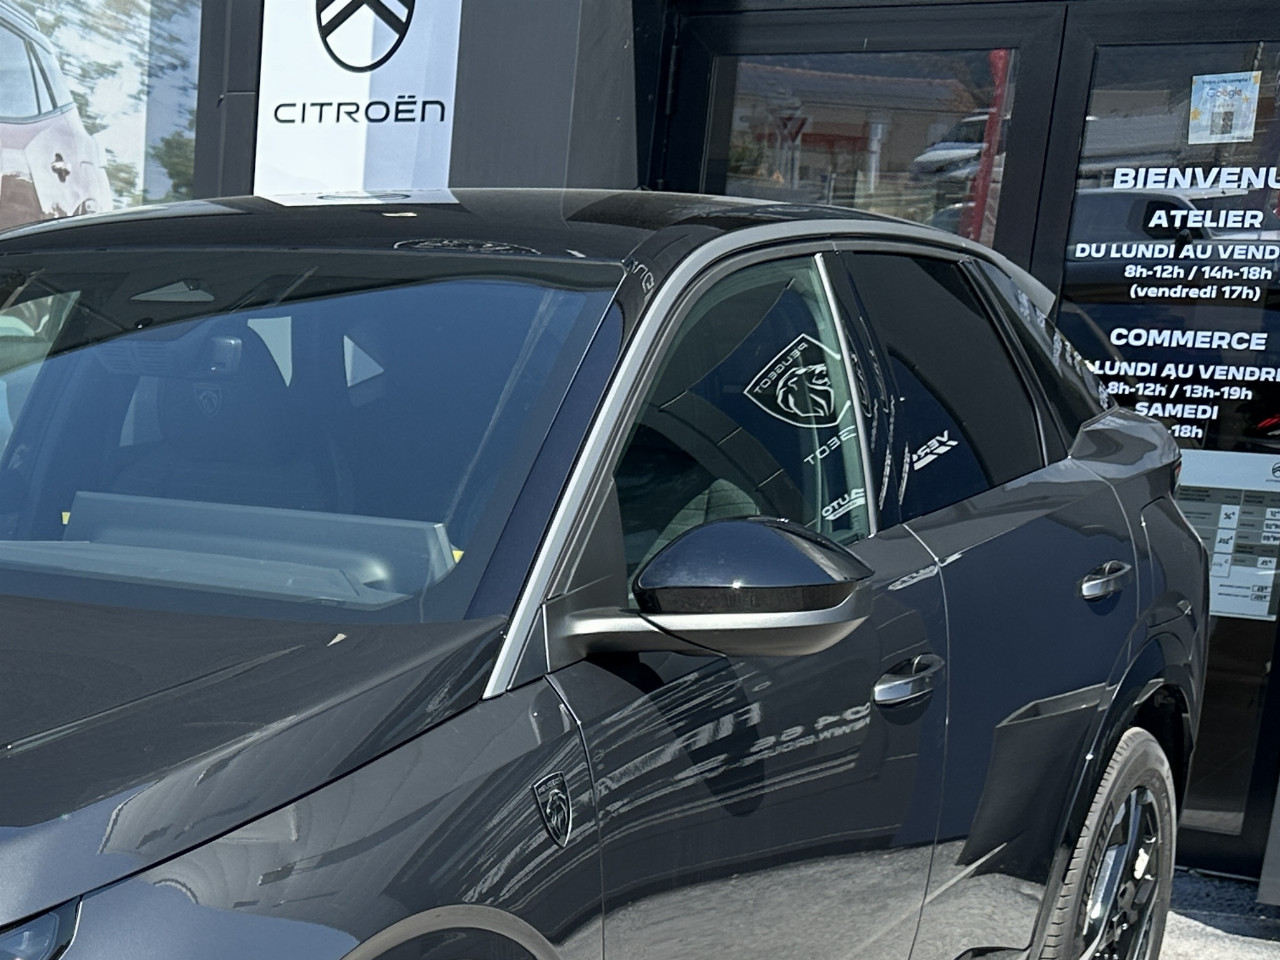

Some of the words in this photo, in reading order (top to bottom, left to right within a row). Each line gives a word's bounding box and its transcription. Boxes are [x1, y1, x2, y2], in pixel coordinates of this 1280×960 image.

[274, 95, 446, 124] CITROËN
[1148, 209, 1264, 228] ATELIER
[1075, 243, 1107, 258] DU
[1110, 243, 1176, 259] LUNDI
[1179, 244, 1212, 259] AU
[1218, 244, 1280, 260] VEND
[1124, 265, 1184, 279] 8h-12h
[1202, 265, 1272, 280] 14h-18h
[1130, 284, 1217, 299] (vendredi
[1221, 285, 1261, 300] 17h)
[1110, 328, 1268, 351] COMMERCE
[1094, 360, 1157, 377] LUNDI
[1161, 362, 1194, 379] AU
[1198, 364, 1280, 382] VENDR
[1107, 381, 1167, 396] 8h-12h
[1183, 384, 1252, 400] 13h-19h
[1135, 401, 1219, 420] SAMEDI
